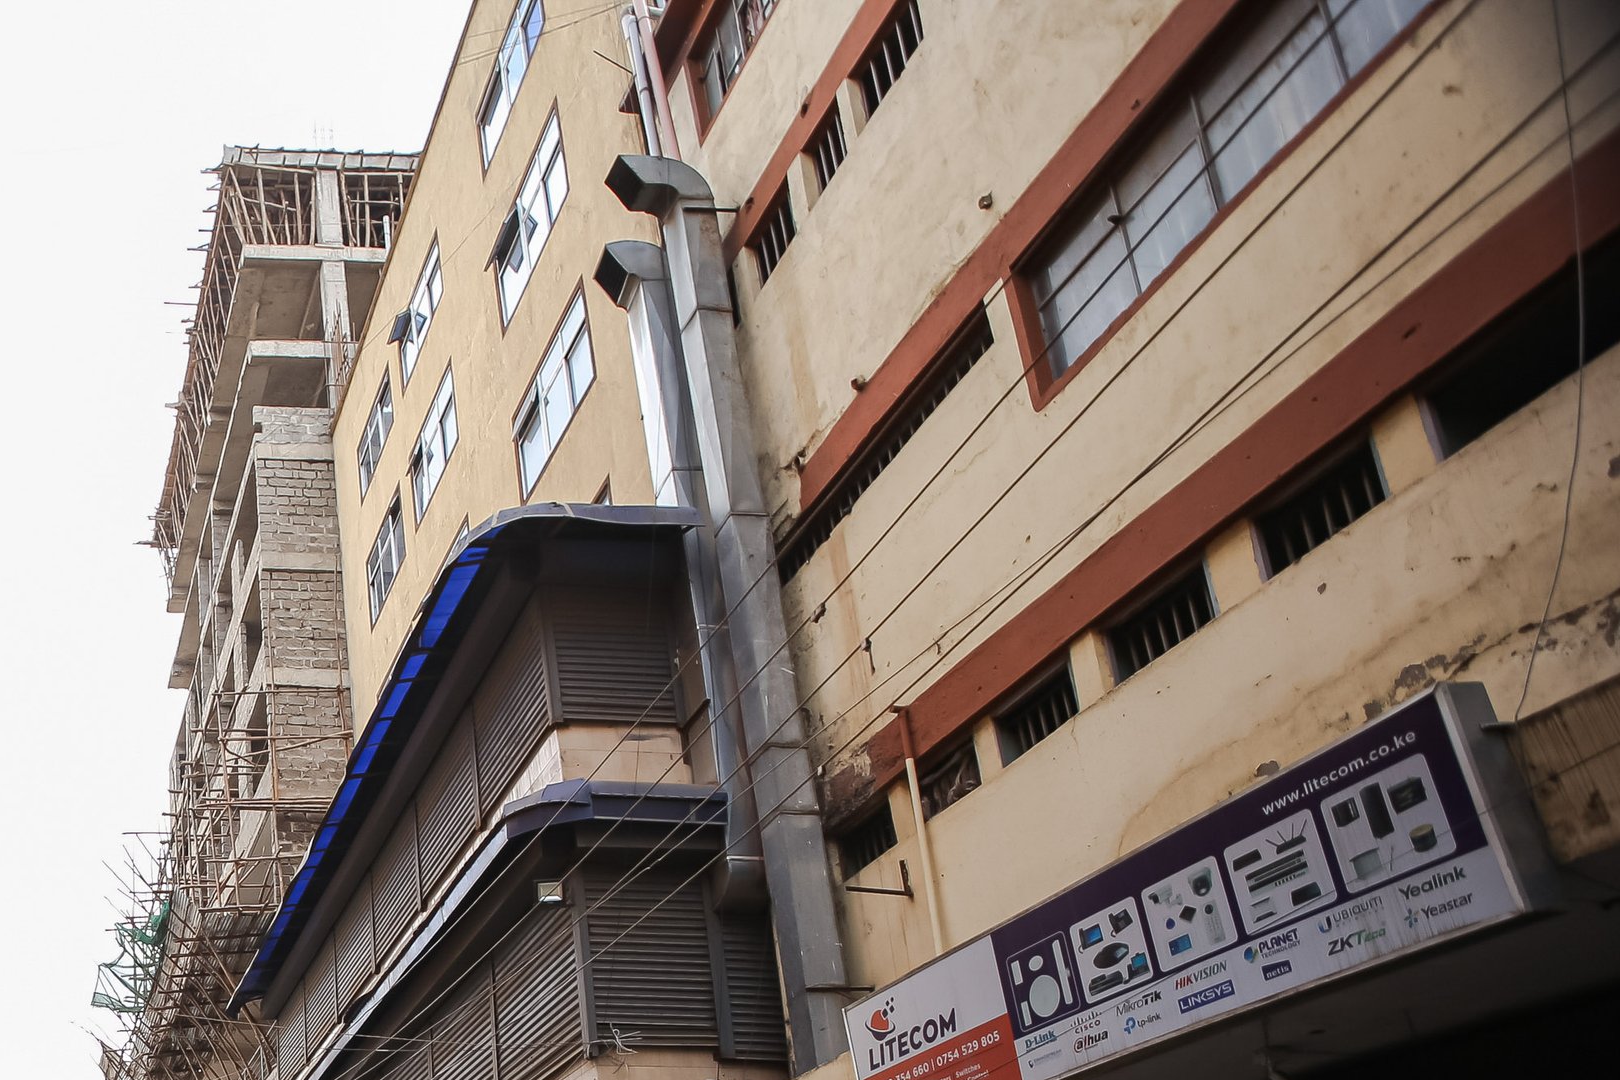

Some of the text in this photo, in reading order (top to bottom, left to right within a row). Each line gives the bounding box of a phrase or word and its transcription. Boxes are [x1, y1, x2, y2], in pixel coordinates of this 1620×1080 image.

[1262, 731, 1415, 816] www.litecom.co.ke
[1398, 867, 1467, 900] Yealink
[1332, 895, 1383, 923] UBIQUITI
[1421, 892, 1473, 920] Yeastar
[1259, 928, 1299, 954] PLANET
[1260, 940, 1301, 959] TECHNOLOGY
[1175, 960, 1227, 990] HIKVISION
[1265, 964, 1291, 979] netis
[1116, 990, 1162, 1017] MikroTik
[1179, 983, 1233, 1010] LINKSYS
[1137, 1012, 1161, 1028] tp-link
[869, 1007, 957, 1071] LITECOM
[1025, 1029, 1056, 1049] D-Link
[912, 1062, 929, 1078] 660
[936, 1048, 960, 1066] 0754
[961, 1041, 979, 1056] 529
[980, 1030, 1000, 1047] 805
[955, 1062, 981, 1078] Switches
